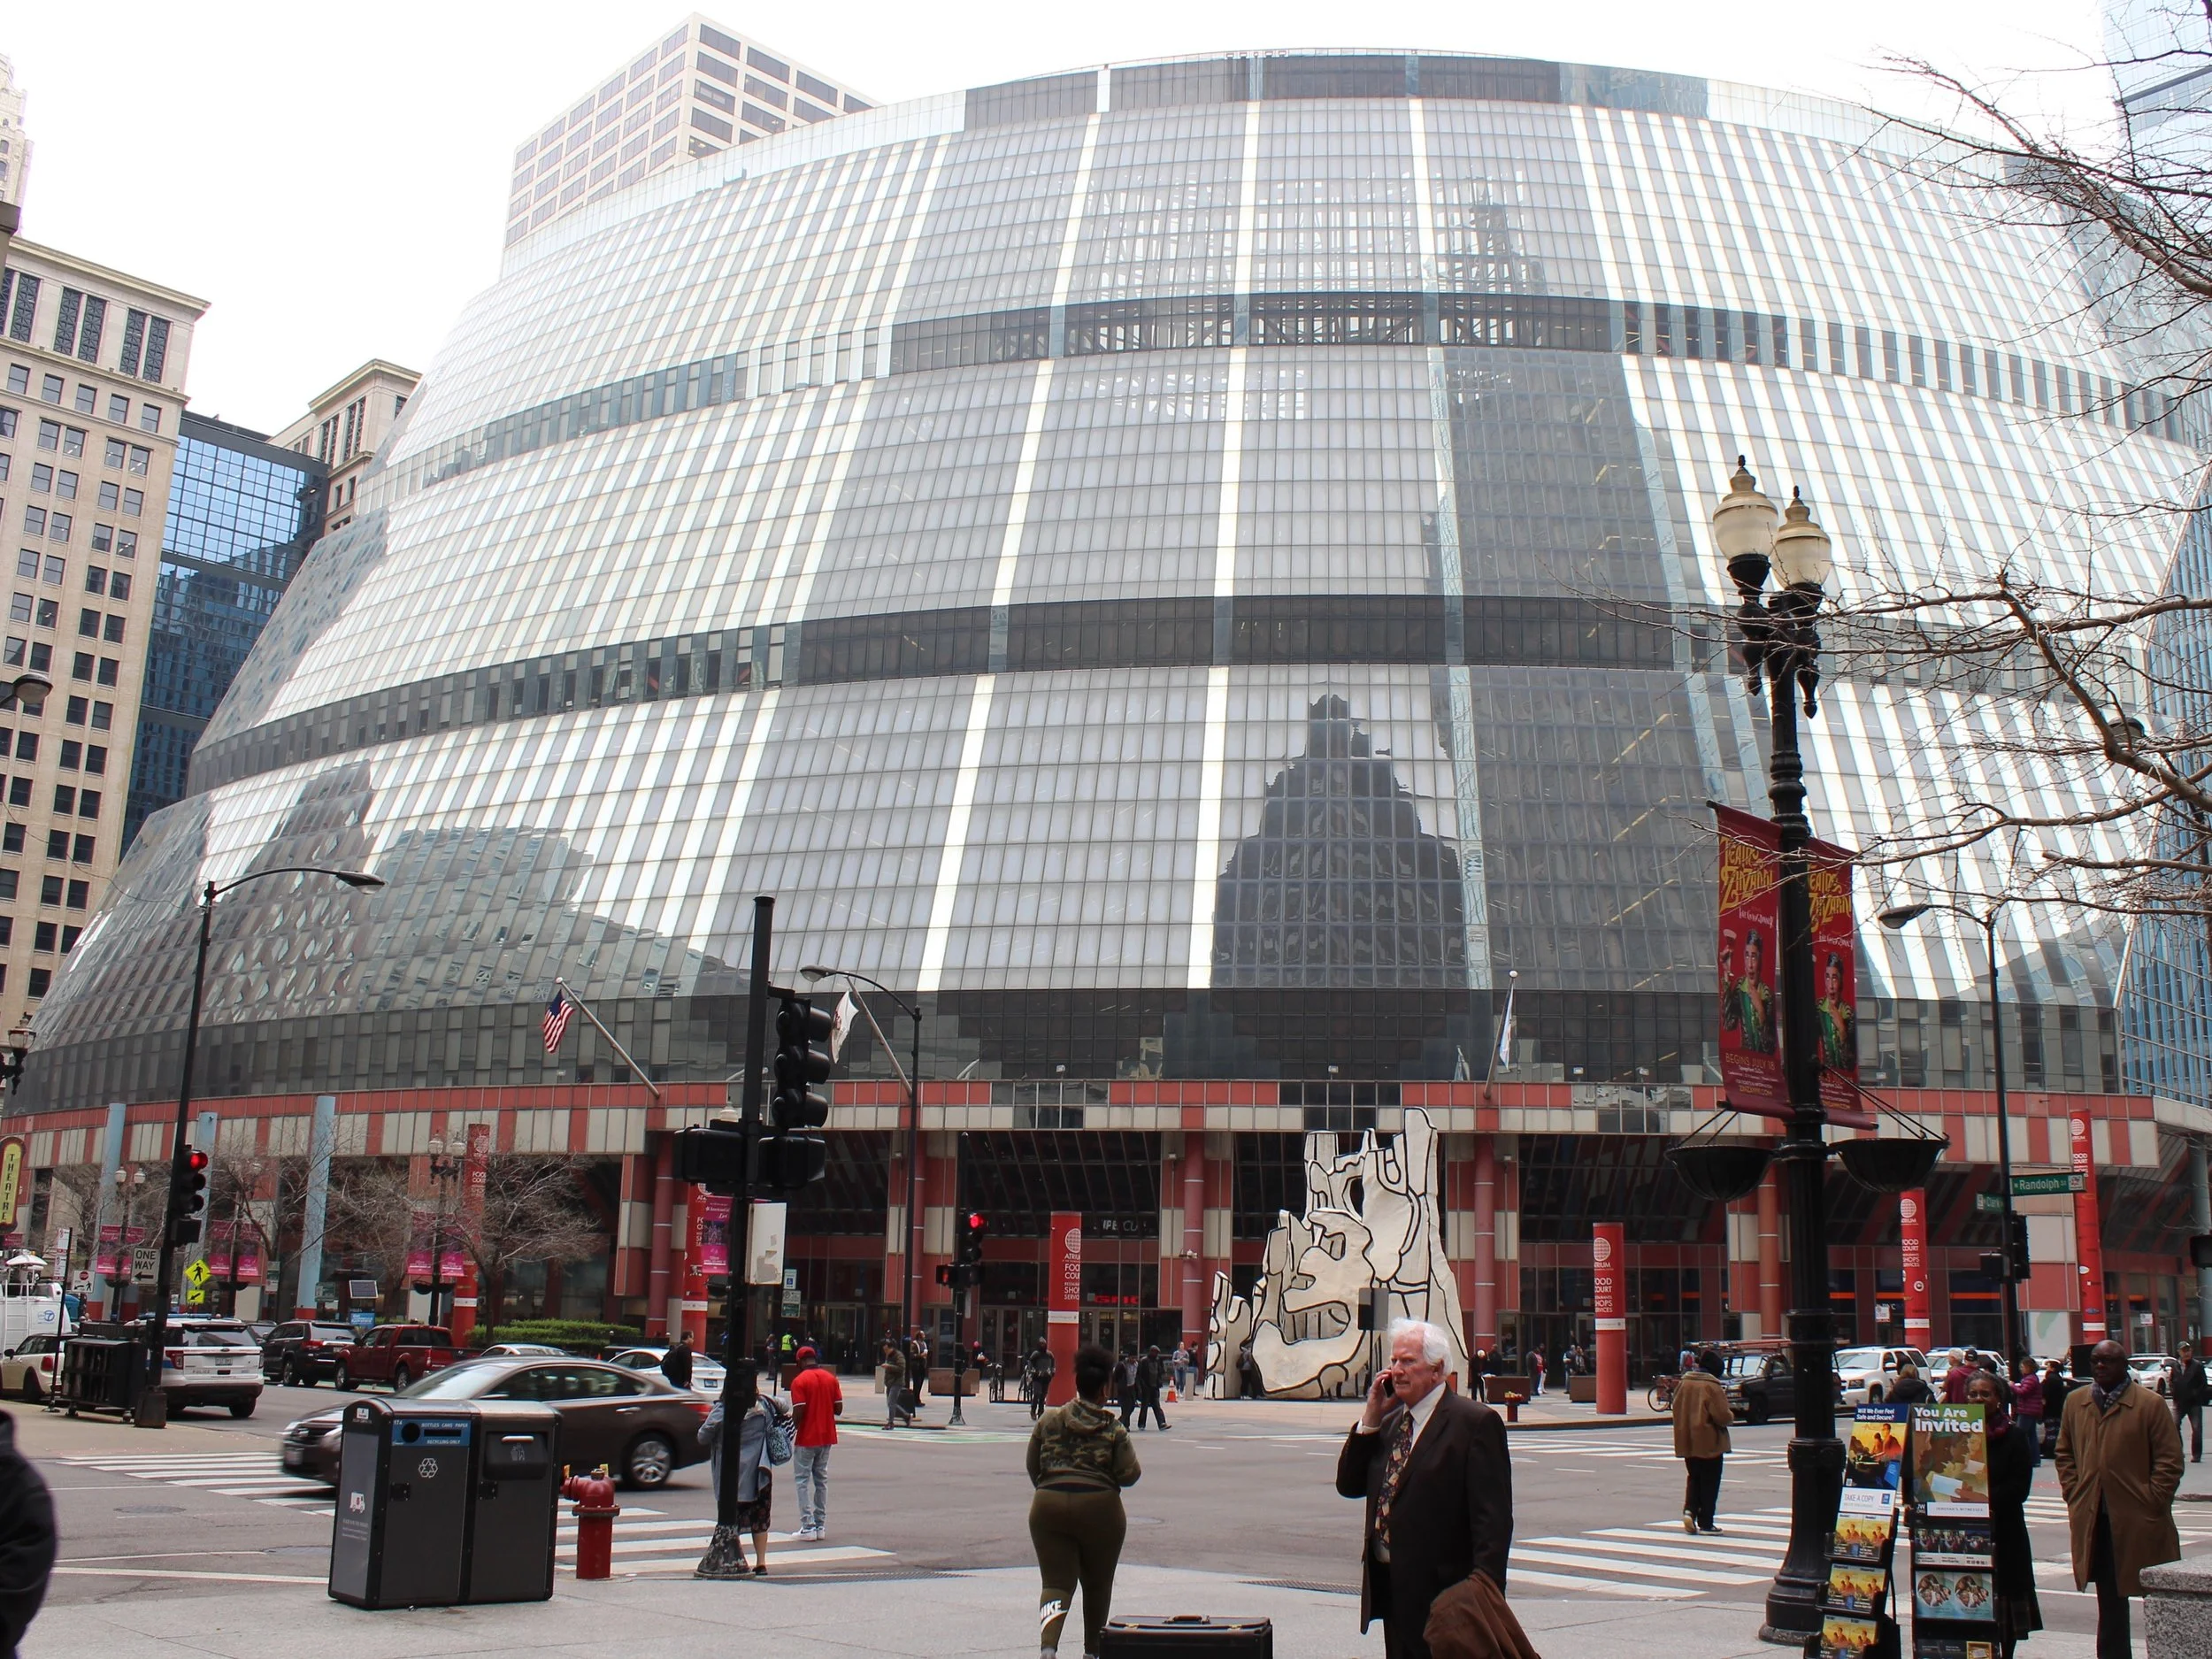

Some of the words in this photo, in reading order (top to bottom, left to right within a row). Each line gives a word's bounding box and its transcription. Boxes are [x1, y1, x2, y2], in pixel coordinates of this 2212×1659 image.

[1725, 1052, 1750, 1066] BEGINS
[2, 1153, 14, 1221] THEATRE
[2019, 1178, 2060, 1191] Randolph
[135, 1250, 157, 1260] ONE
[134, 1260, 155, 1270] WAY
[1914, 1407, 1939, 1417] You
[1943, 1407, 1968, 1417] Are
[1915, 1417, 1984, 1432] Invited
